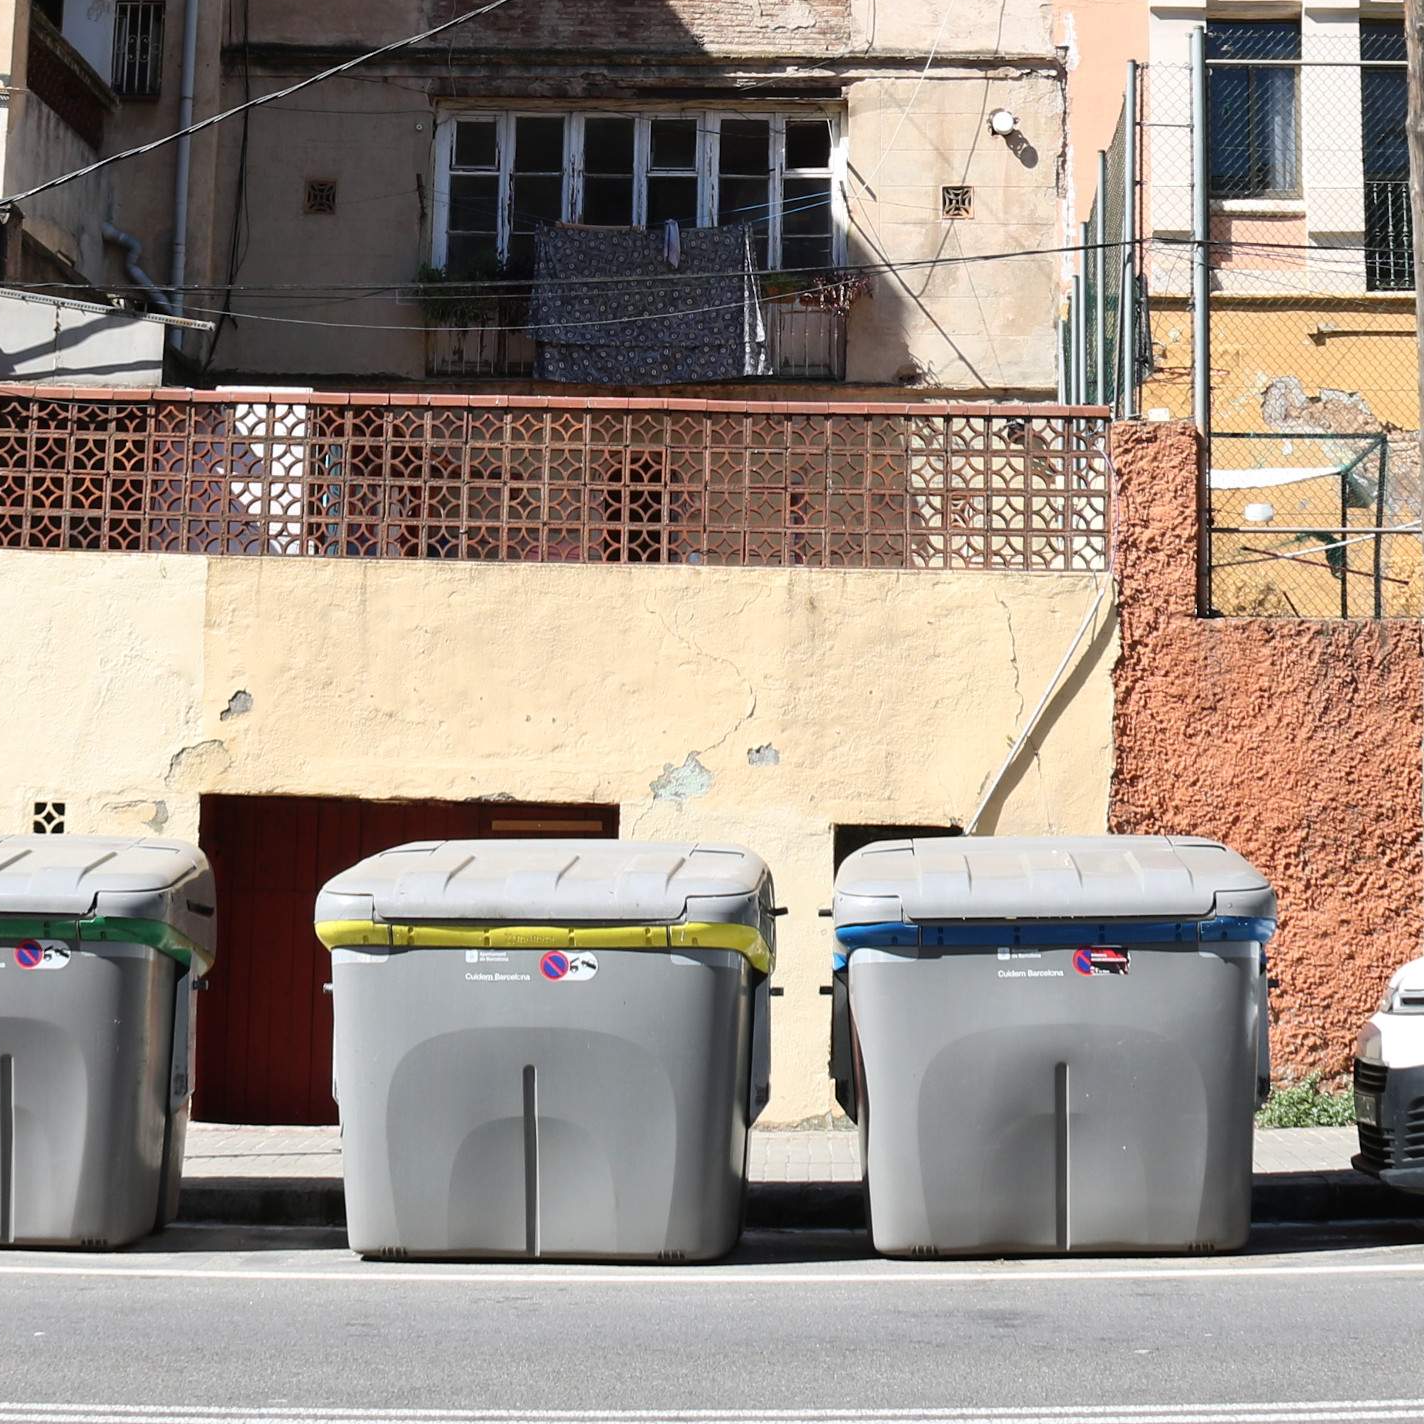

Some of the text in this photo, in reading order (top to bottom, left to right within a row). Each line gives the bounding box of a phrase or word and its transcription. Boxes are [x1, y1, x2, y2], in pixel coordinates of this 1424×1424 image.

[464, 972, 531, 982] Cuidem Barcelona
[997, 968, 1064, 978] Cuidem Barcelona
